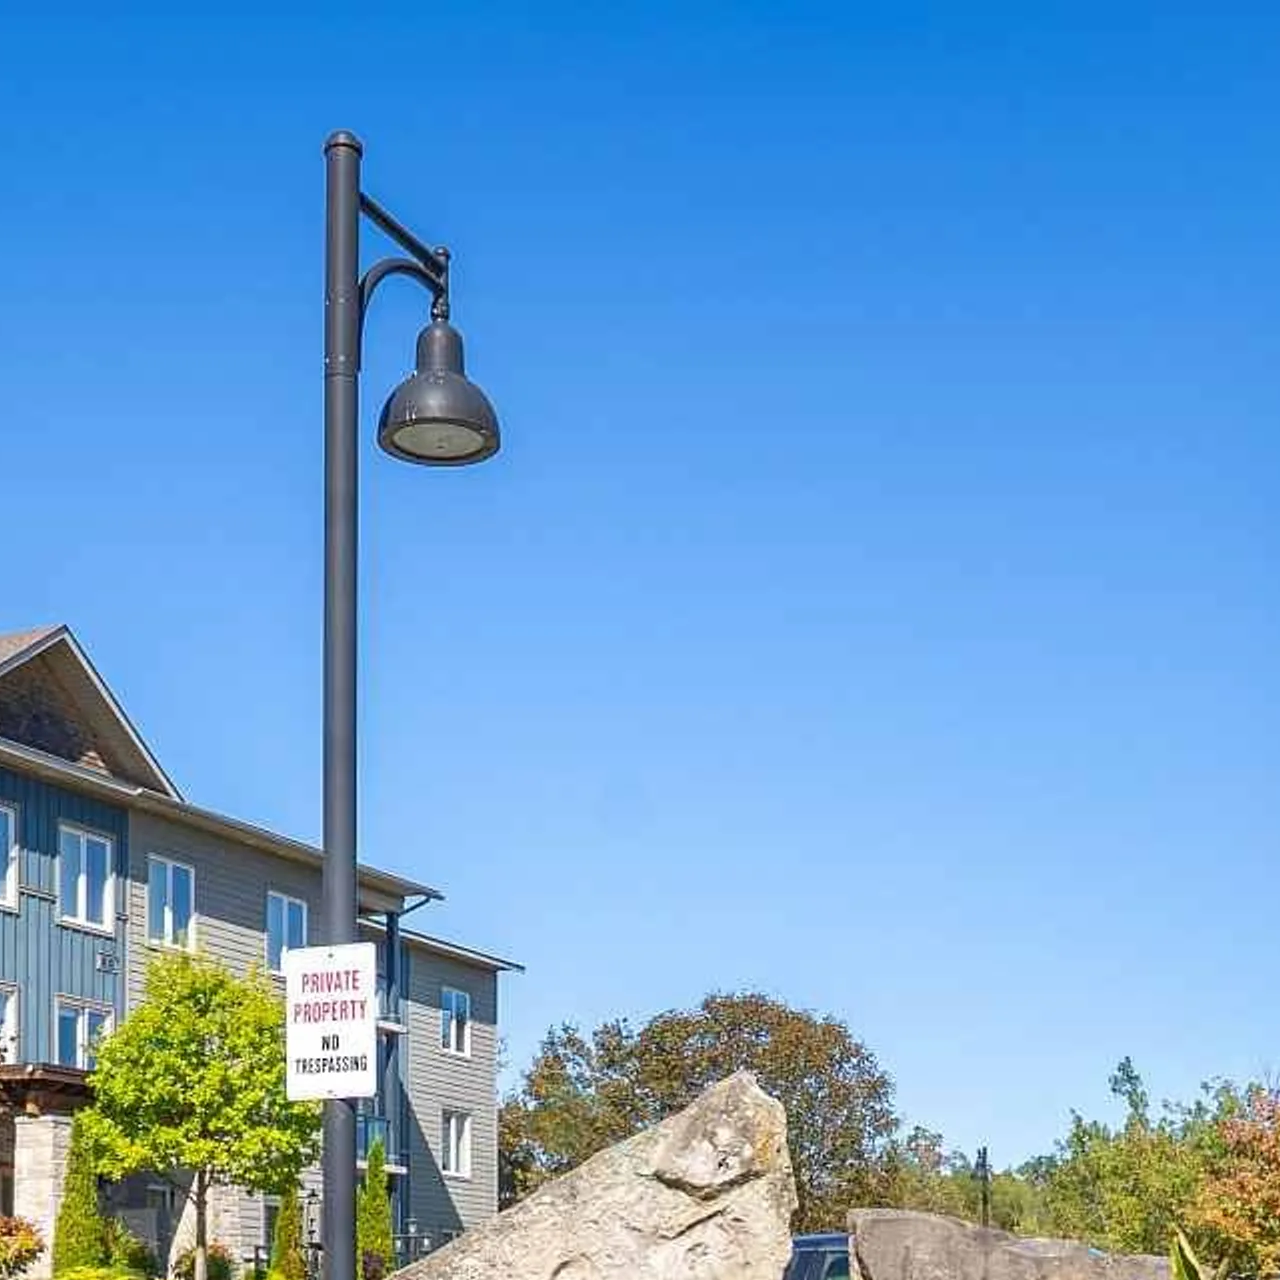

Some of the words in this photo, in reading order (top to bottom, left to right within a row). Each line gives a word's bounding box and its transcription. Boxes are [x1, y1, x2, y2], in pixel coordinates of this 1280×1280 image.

[301, 969, 361, 994] PRIVATE
[293, 998, 368, 1024] PROPERTY
[321, 1033, 340, 1052] NO
[294, 1055, 368, 1075] TRESPASSING
